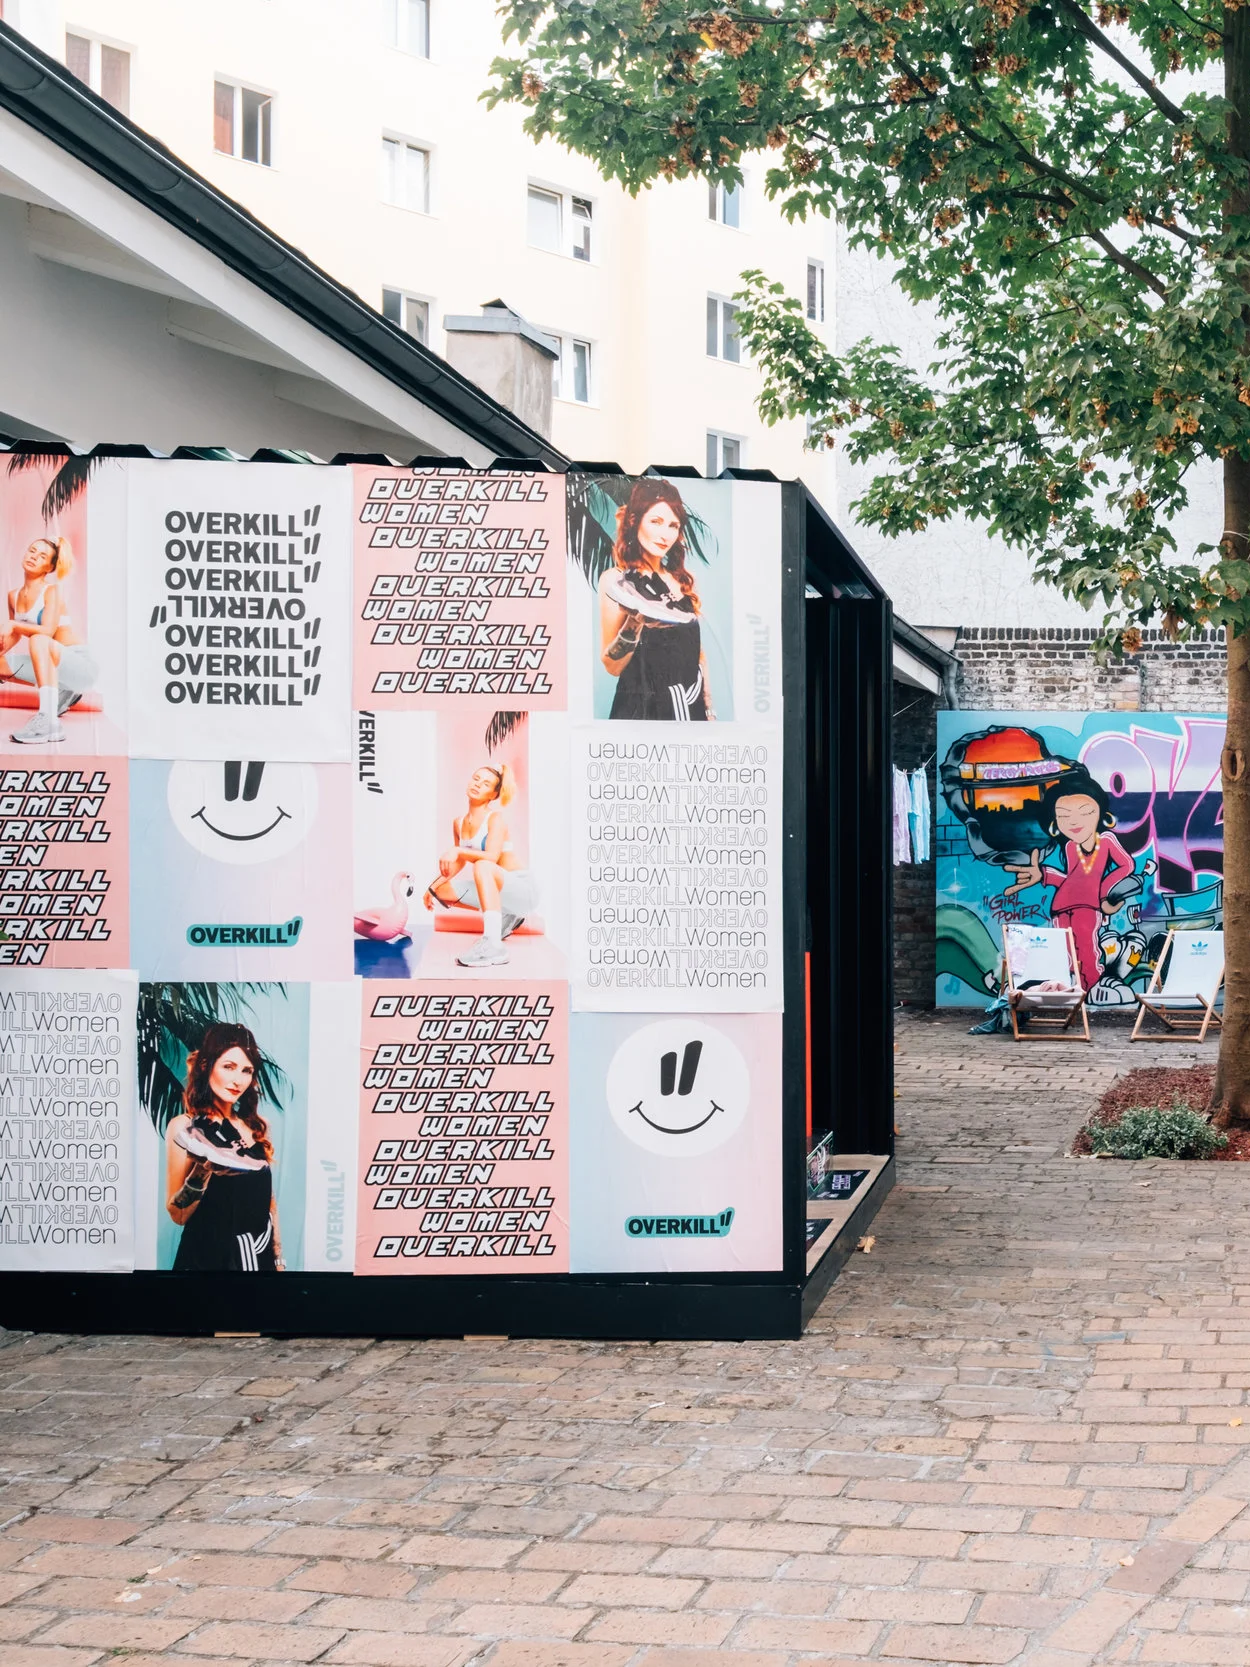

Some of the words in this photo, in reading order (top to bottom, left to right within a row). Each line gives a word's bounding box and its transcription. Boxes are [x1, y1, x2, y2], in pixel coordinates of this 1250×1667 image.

[367, 479, 548, 502] OVERKILL
[359, 503, 489, 525] WOMEN
[368, 527, 549, 550] OVERKILL
[414, 552, 543, 574] WOMEN
[370, 575, 550, 598] OVERKILL
[361, 599, 491, 622] WOMEN
[370, 623, 551, 646] OVERKILL
[416, 647, 545, 670] WOMEN
[371, 671, 553, 695] OVERKILL
[0, 770, 110, 793] RKILL
[0, 819, 111, 842] RKILL
[0, 869, 111, 892] RKILL
[0, 918, 112, 941] RKILL
[371, 995, 555, 1018] OVERKILL
[417, 1019, 549, 1041] WOMEN
[371, 1043, 555, 1066] OVERKILL
[363, 1067, 494, 1089] WOMEN
[372, 1091, 555, 1114] OVERKILL
[418, 1115, 549, 1137] WOMEN
[372, 1138, 555, 1161] OVERKILL
[364, 1163, 495, 1185] WOMEN
[373, 1186, 555, 1209] OVERKILL
[419, 1211, 549, 1233] WOMEN
[373, 1234, 556, 1257] OVERKILL
